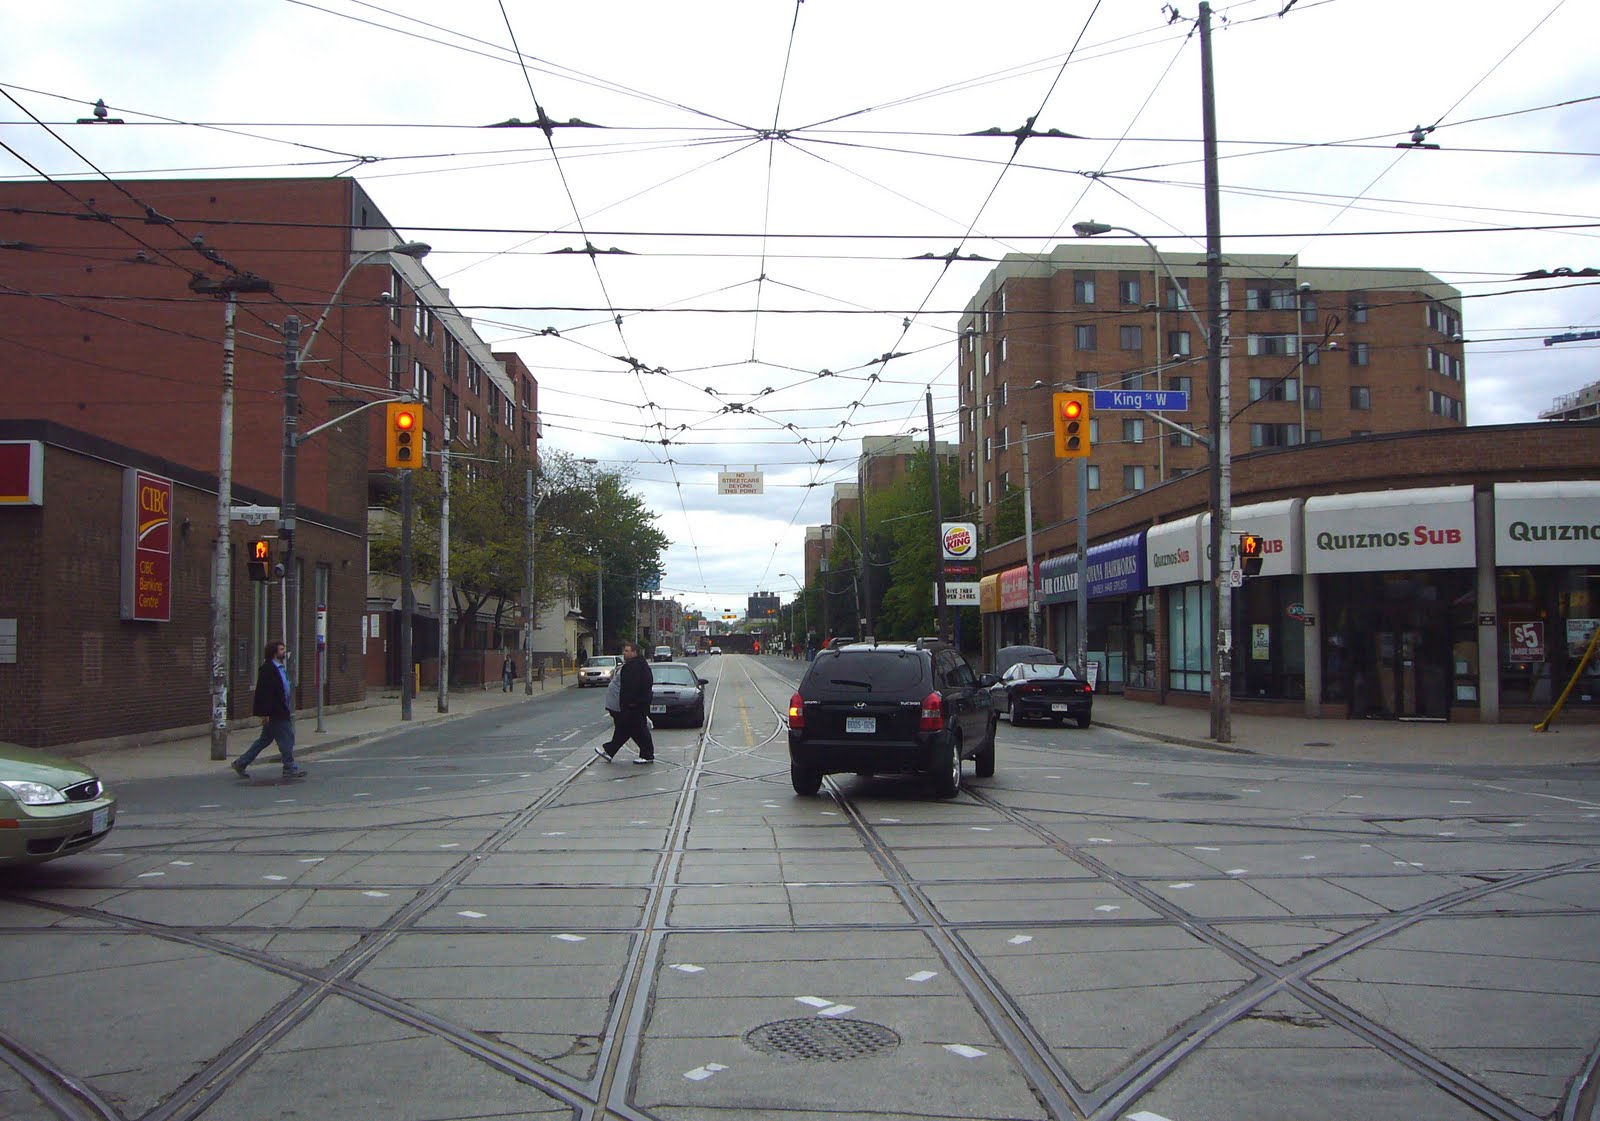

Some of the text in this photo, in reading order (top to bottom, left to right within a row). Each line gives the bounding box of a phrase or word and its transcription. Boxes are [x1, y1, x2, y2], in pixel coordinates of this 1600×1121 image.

[1114, 393, 1142, 409] King
[1155, 393, 1167, 406] W
[141, 486, 169, 515] CIBC
[945, 531, 970, 543] BURGER
[947, 537, 971, 550] KING
[1317, 532, 1410, 550] Quiznos
[139, 560, 154, 575] CIBC
[139, 577, 163, 596] Banking
[138, 594, 159, 608] Centre
[1256, 628, 1265, 640] $5
[1514, 623, 1538, 648] $5
[1253, 640, 1269, 649] LARGE
